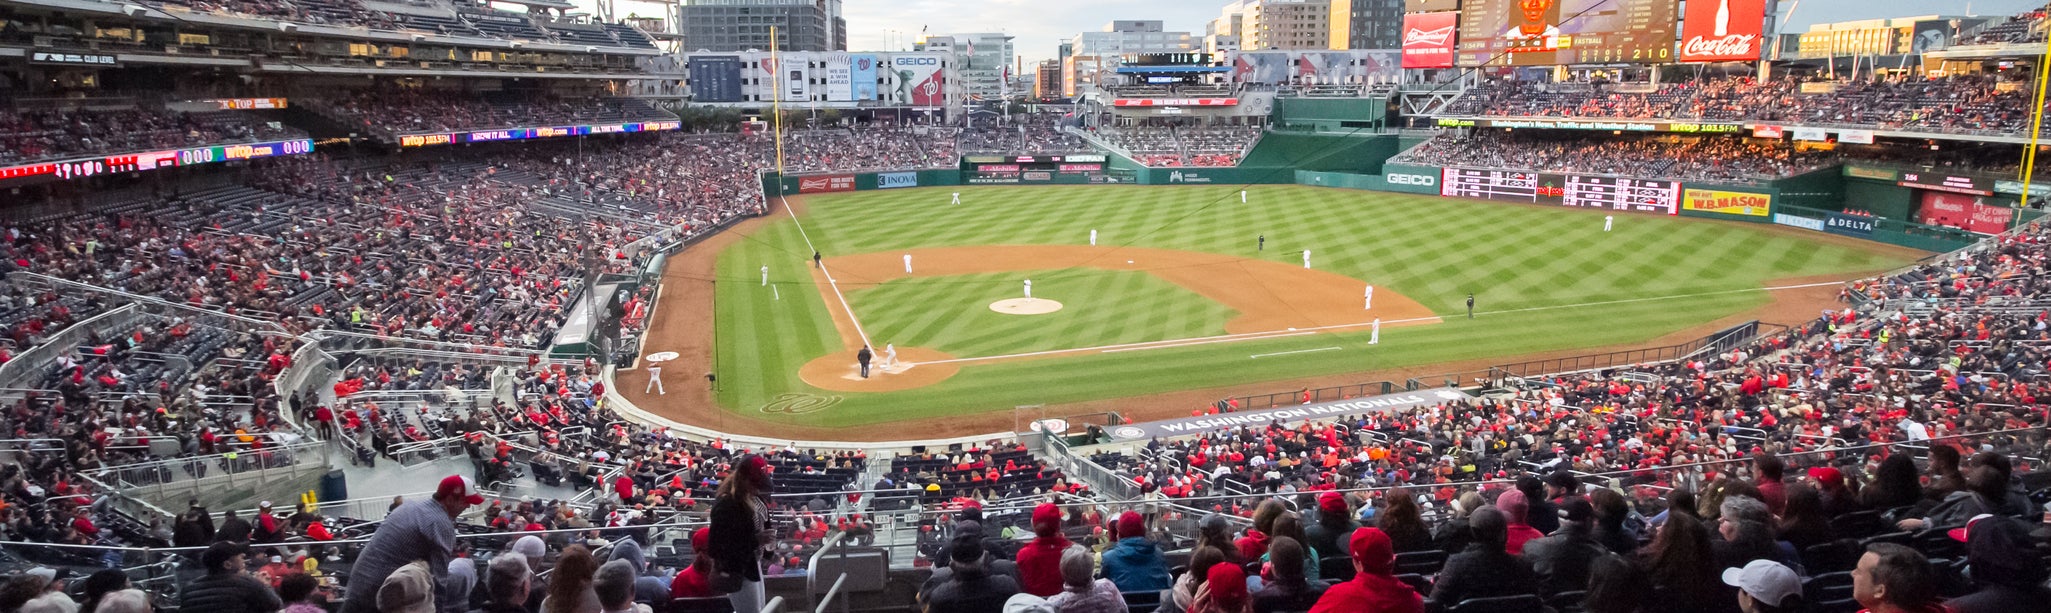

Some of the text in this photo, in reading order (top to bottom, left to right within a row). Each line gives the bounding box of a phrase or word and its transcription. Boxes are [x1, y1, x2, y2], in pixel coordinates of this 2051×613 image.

[1574, 37, 1602, 45] FASTBALL
[1684, 34, 1756, 56] Coca-Cola
[1633, 48, 1667, 59] 2 1 0
[896, 57, 936, 66] GEICO
[1557, 121, 1578, 129] Traffic
[224, 145, 273, 159] wtop.com
[888, 176, 916, 184] INOVA
[1387, 173, 1434, 186] GEICO
[1838, 218, 1872, 231] DELTA
[1160, 394, 1425, 432] WASHINGTON NATIONALS
